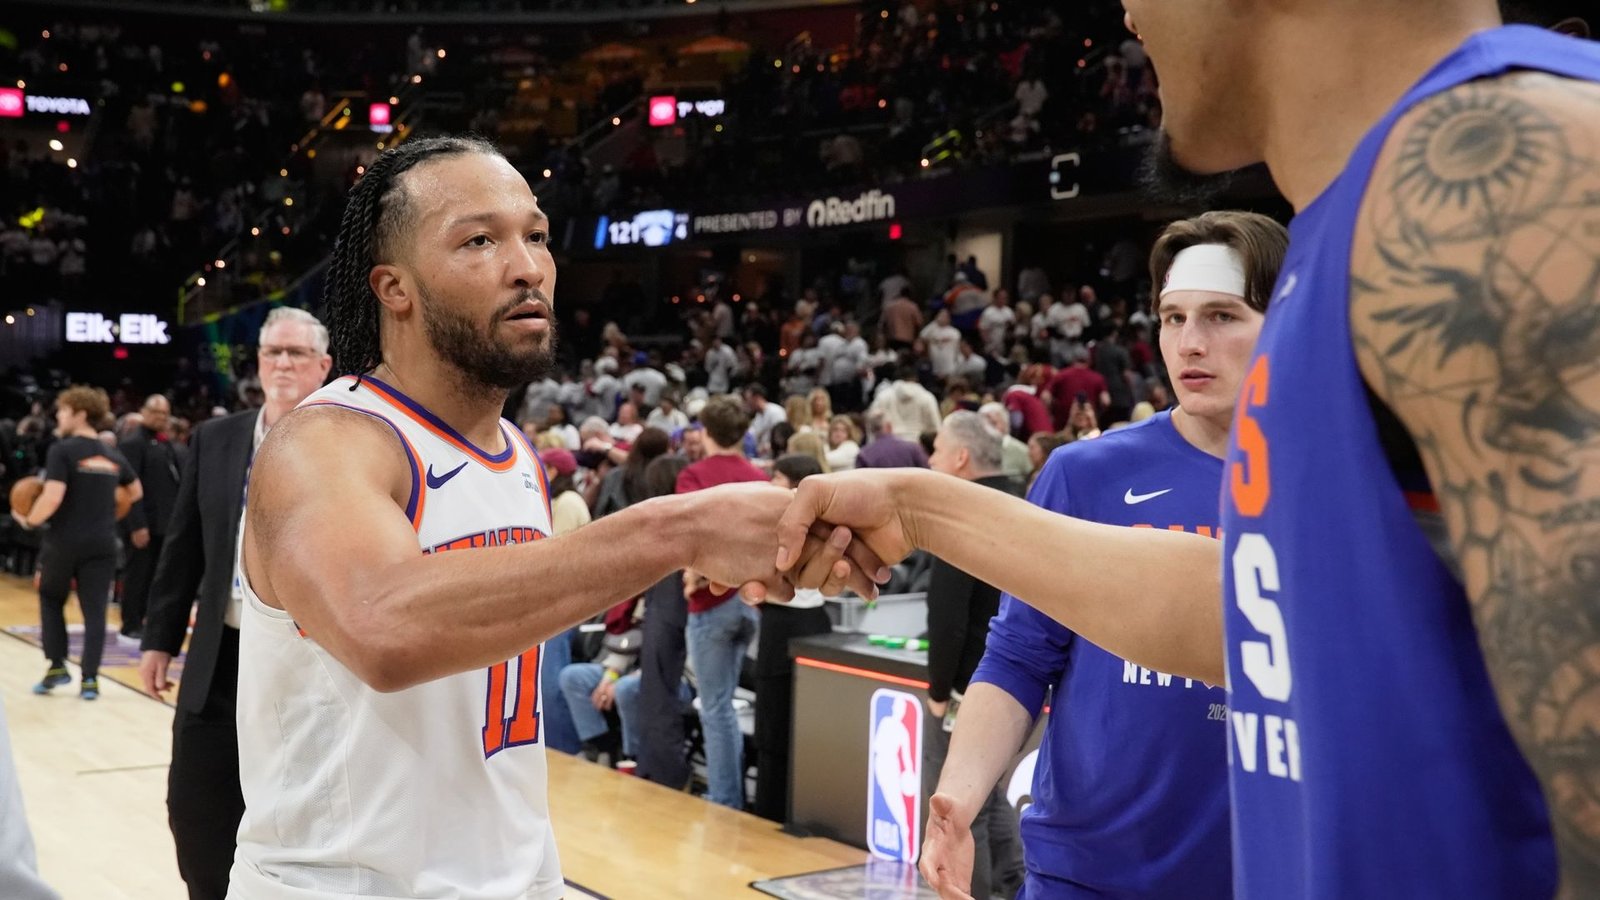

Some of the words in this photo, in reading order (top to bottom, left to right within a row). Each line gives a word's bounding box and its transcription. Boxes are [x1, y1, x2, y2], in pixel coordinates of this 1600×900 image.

[25, 95, 91, 115] TOYOTA
[694, 210, 778, 234] PRESENTED
[782, 207, 803, 228] BY
[826, 189, 896, 226] Redfin
[608, 220, 641, 245] 121
[66, 312, 115, 343] Elk
[120, 313, 169, 345] Elk
